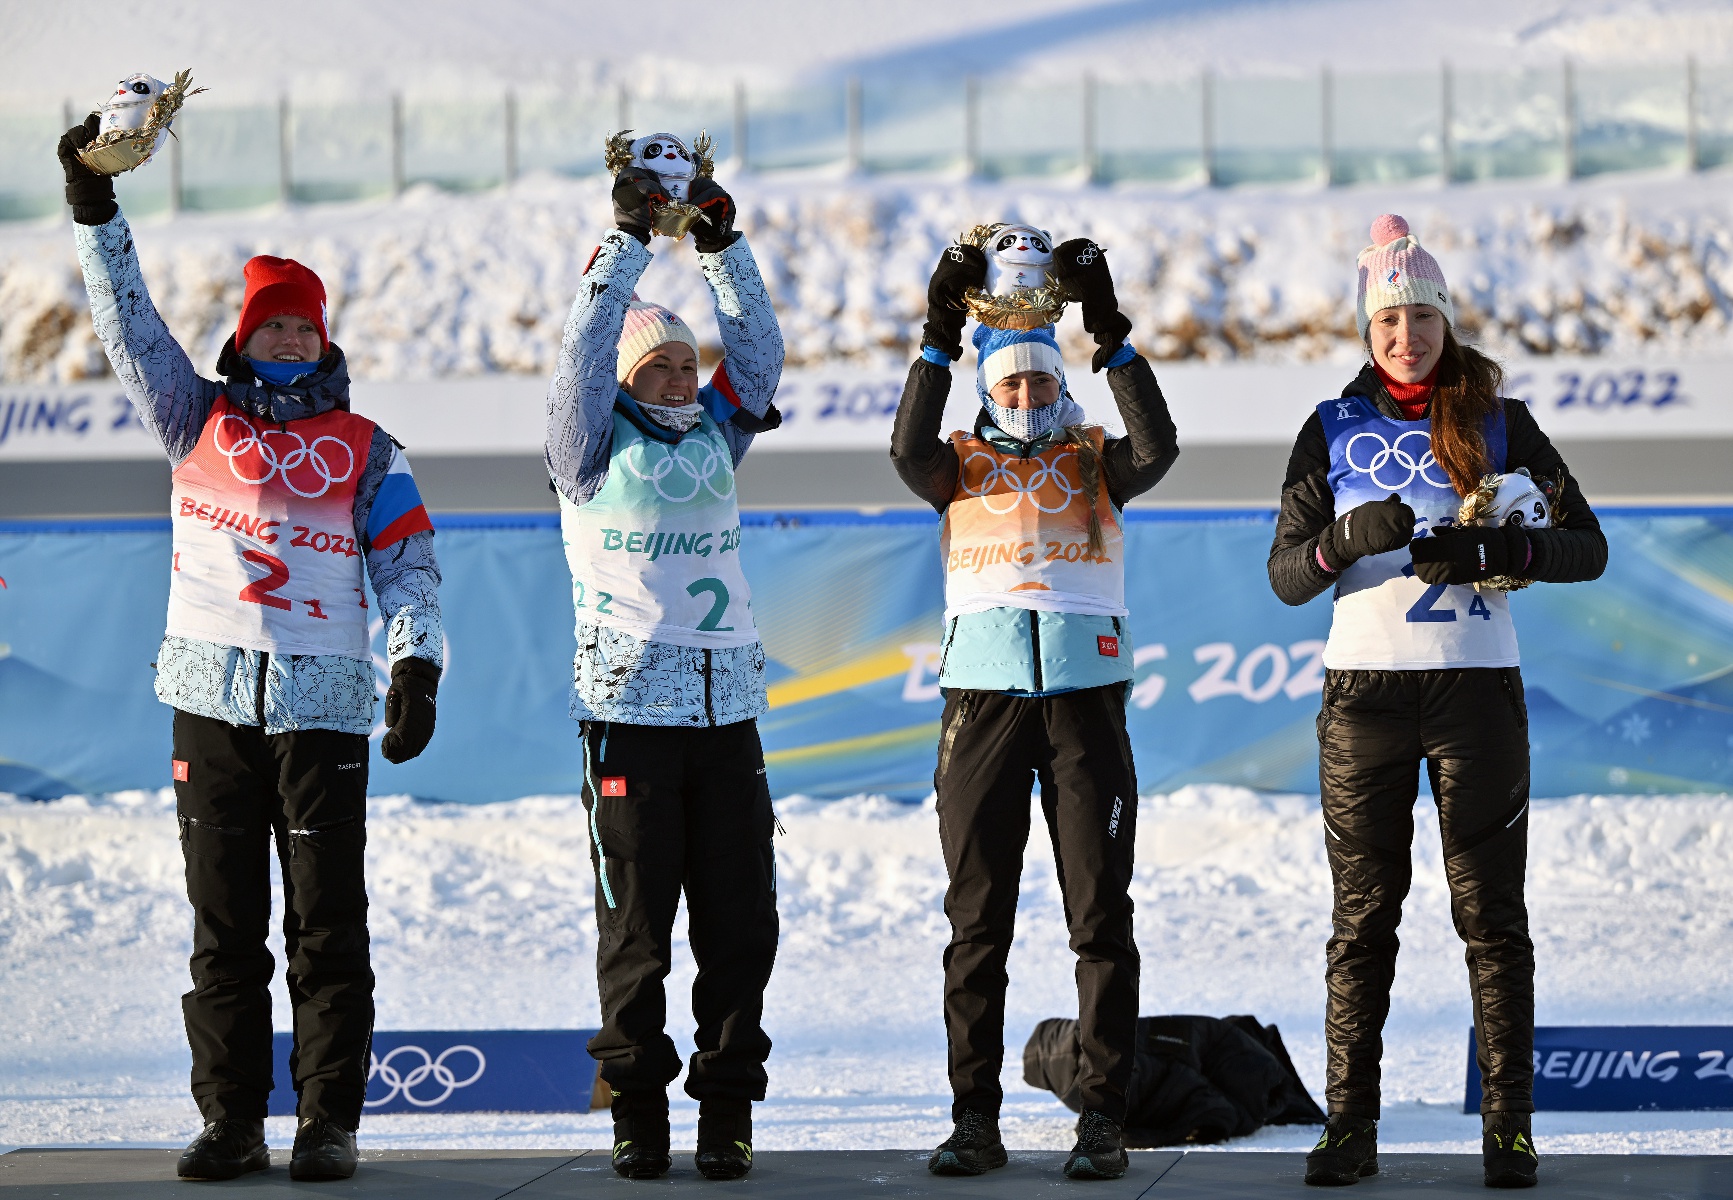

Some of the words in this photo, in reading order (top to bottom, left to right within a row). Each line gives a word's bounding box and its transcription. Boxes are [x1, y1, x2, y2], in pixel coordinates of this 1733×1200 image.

[816, 382, 906, 422] 202
[1554, 368, 1692, 411] 2022
[0, 392, 92, 443] JING
[179, 496, 281, 545] BEIJING
[289, 525, 362, 559] 2022
[600, 528, 714, 562] BEIJING
[948, 541, 1035, 574] BEIJING
[1043, 541, 1113, 565] 2022
[238, 549, 292, 612] 2
[303, 598, 329, 620] 1
[595, 591, 613, 615] 2
[685, 577, 735, 632] 2
[1468, 594, 1492, 621] 4
[1188, 642, 1326, 703] 202
